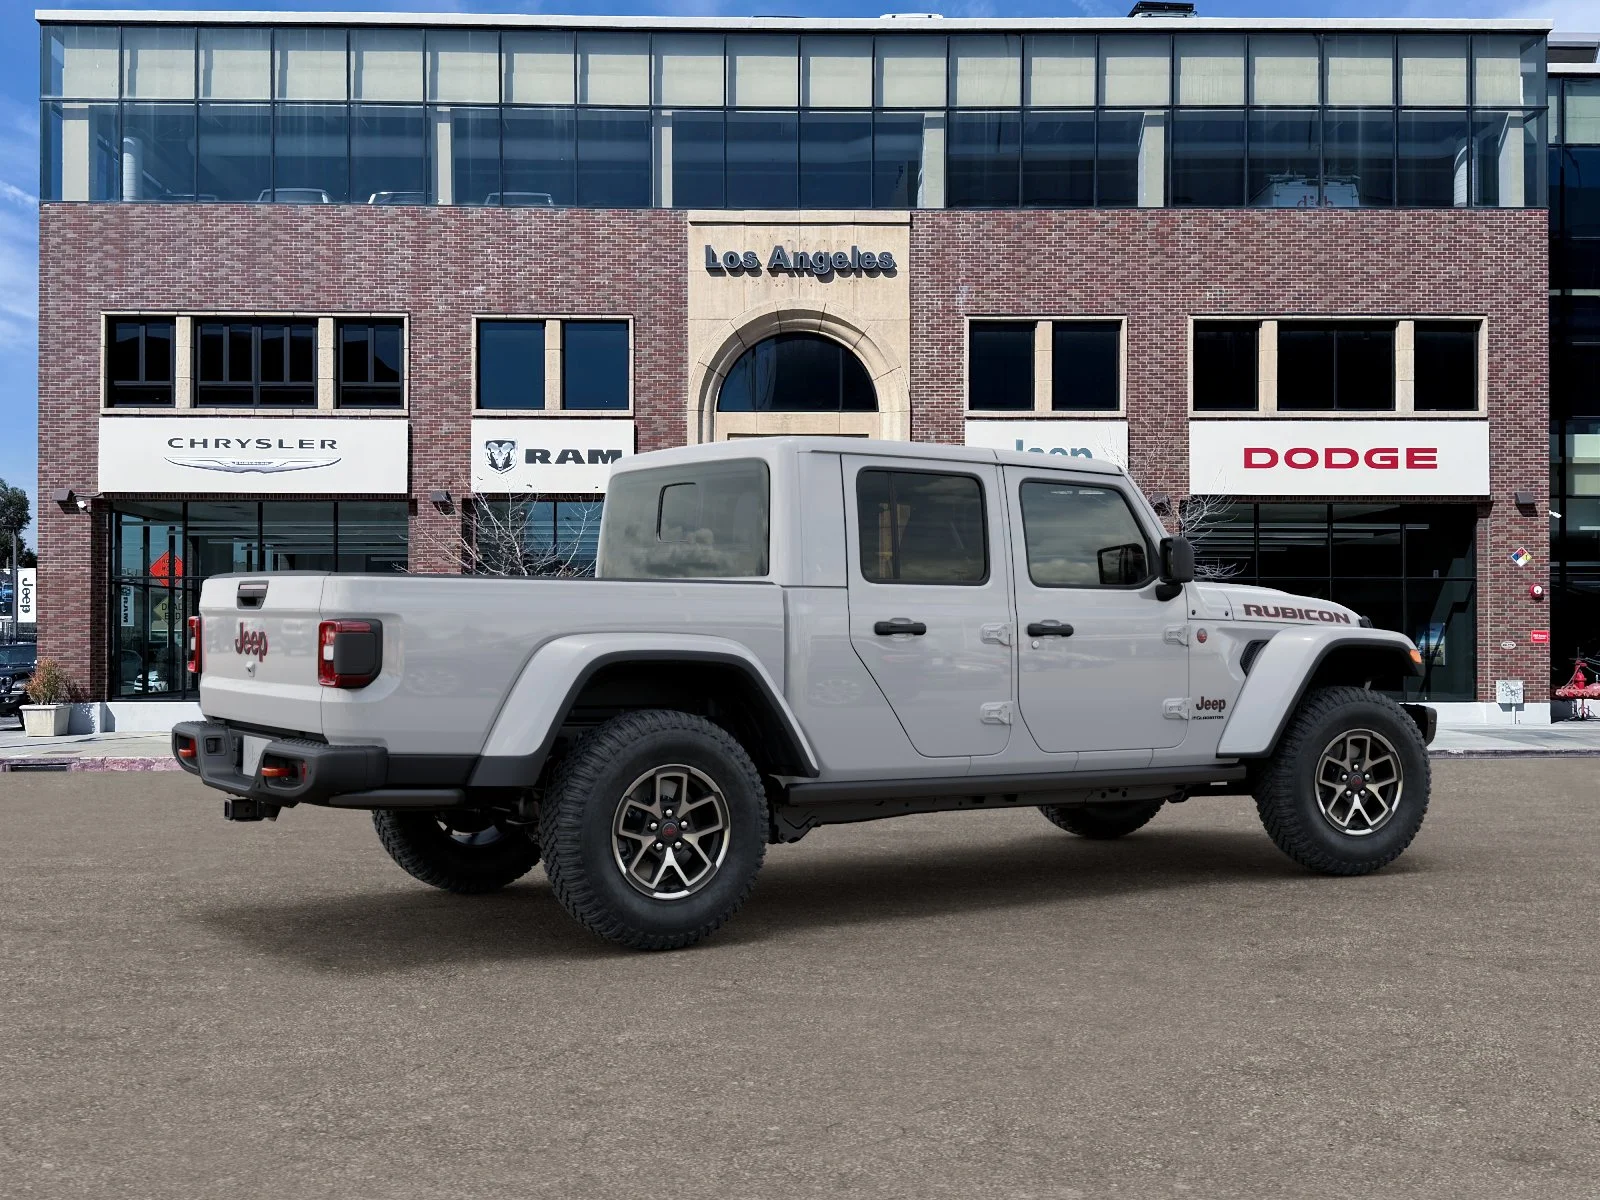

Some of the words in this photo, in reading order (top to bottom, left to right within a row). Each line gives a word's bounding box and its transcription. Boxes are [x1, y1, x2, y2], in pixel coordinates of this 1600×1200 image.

[704, 244, 759, 269] Los
[766, 245, 896, 275] Angeles
[167, 437, 338, 450] CHRYSLER
[524, 448, 623, 465] RAM
[1243, 447, 1438, 470] DODGE
[20, 577, 34, 614] Jeep
[1243, 603, 1351, 624] RUBICON
[234, 621, 269, 663] Jeep
[1195, 695, 1226, 713] Jeep
